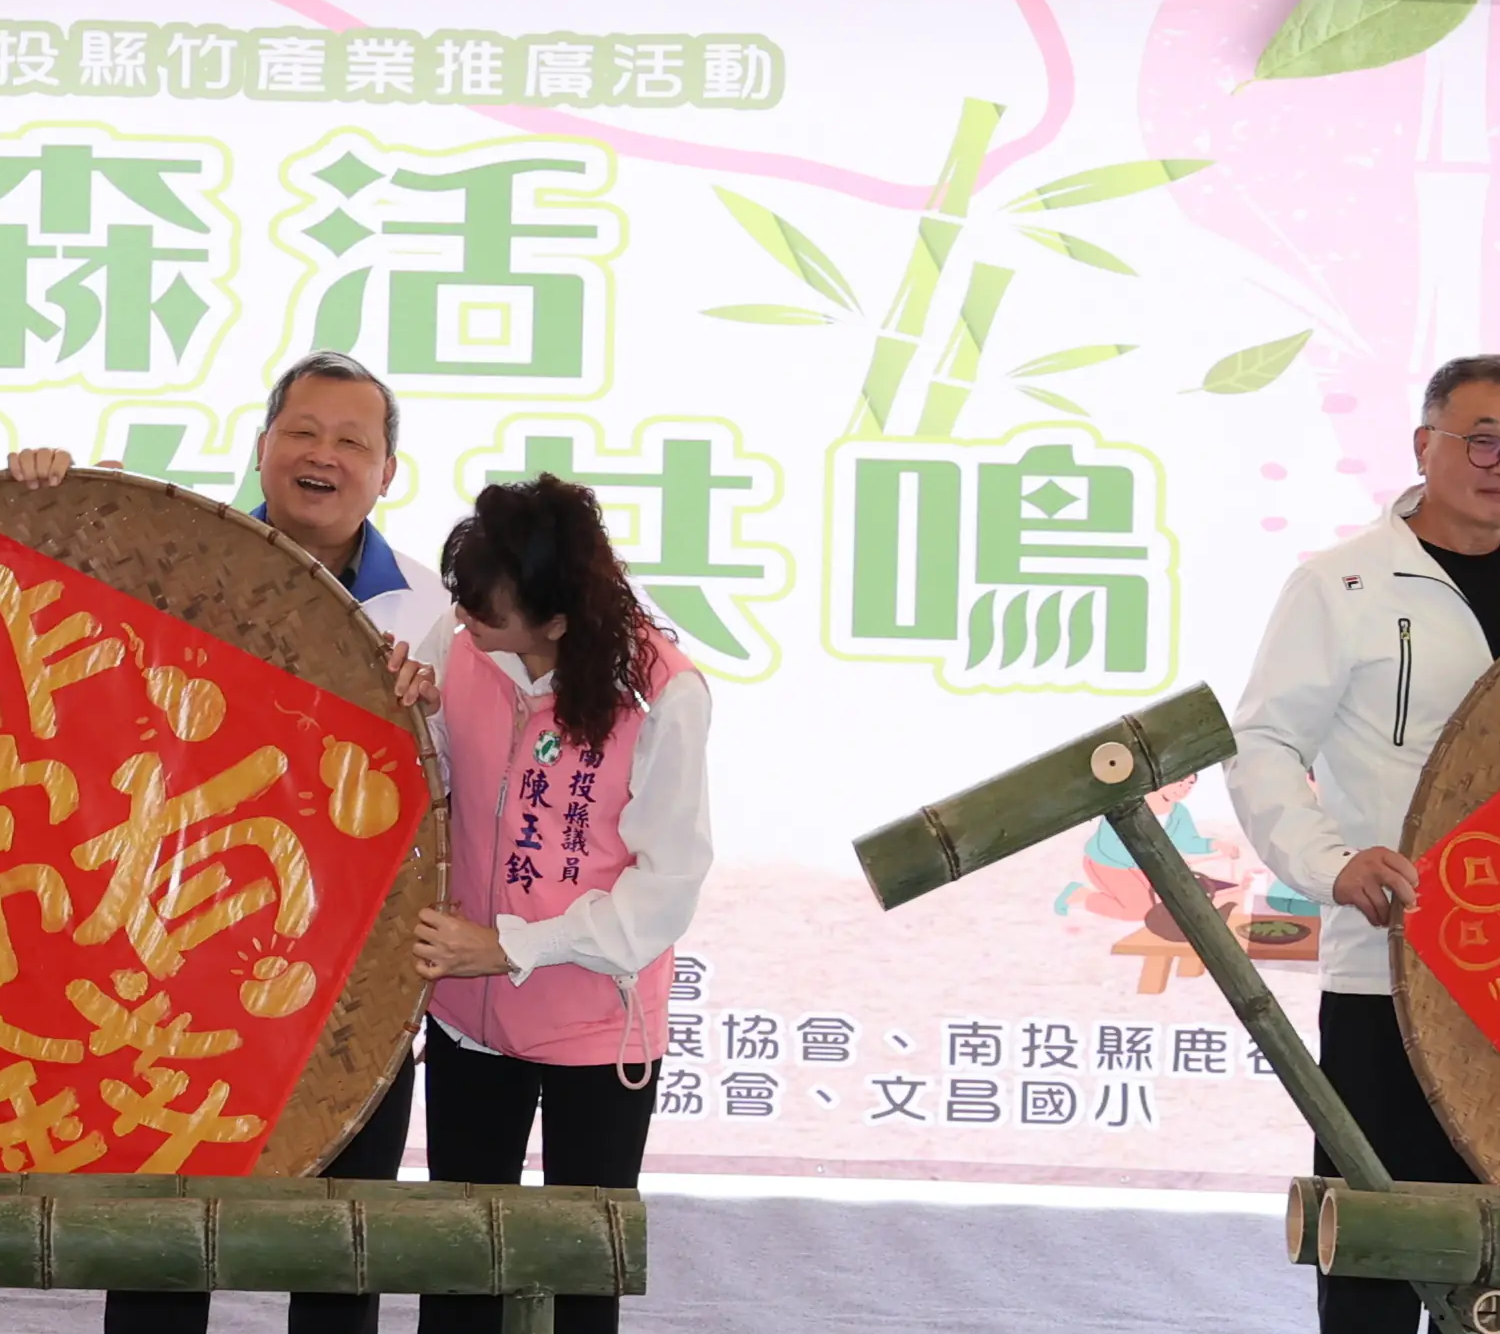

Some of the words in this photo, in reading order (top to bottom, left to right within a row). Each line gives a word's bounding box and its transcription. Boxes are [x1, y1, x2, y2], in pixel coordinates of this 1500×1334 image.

[504, 768, 552, 894] 陳玉鈴
[557, 746, 604, 885] 南投縣議員
